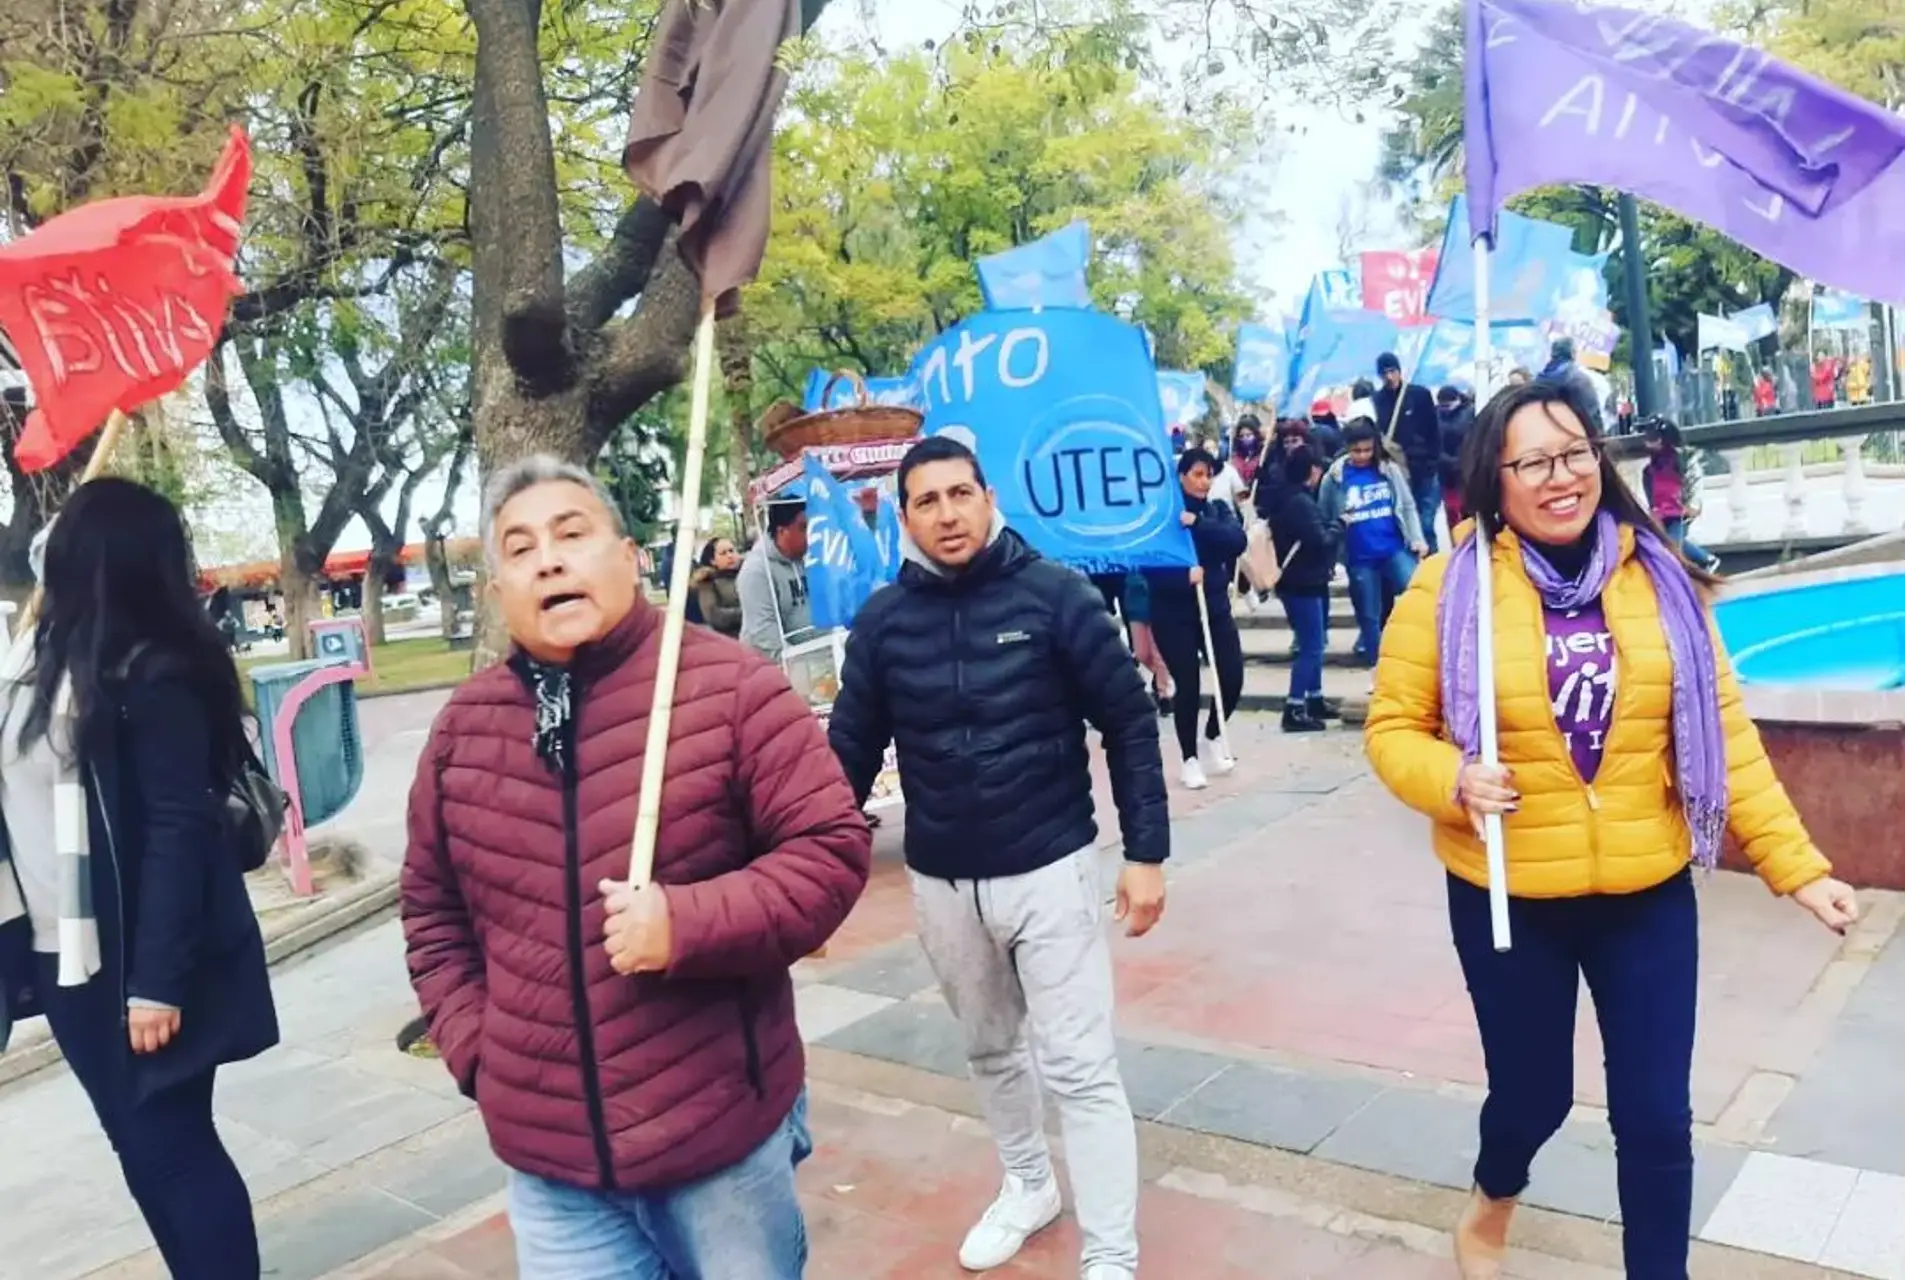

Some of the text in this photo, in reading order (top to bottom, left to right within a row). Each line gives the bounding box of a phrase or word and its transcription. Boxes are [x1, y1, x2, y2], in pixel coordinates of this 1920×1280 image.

[1384, 279, 1427, 319] EVI
[923, 327, 1049, 408] nto
[1024, 446, 1166, 518] UTEP
[804, 515, 858, 573] EVI
